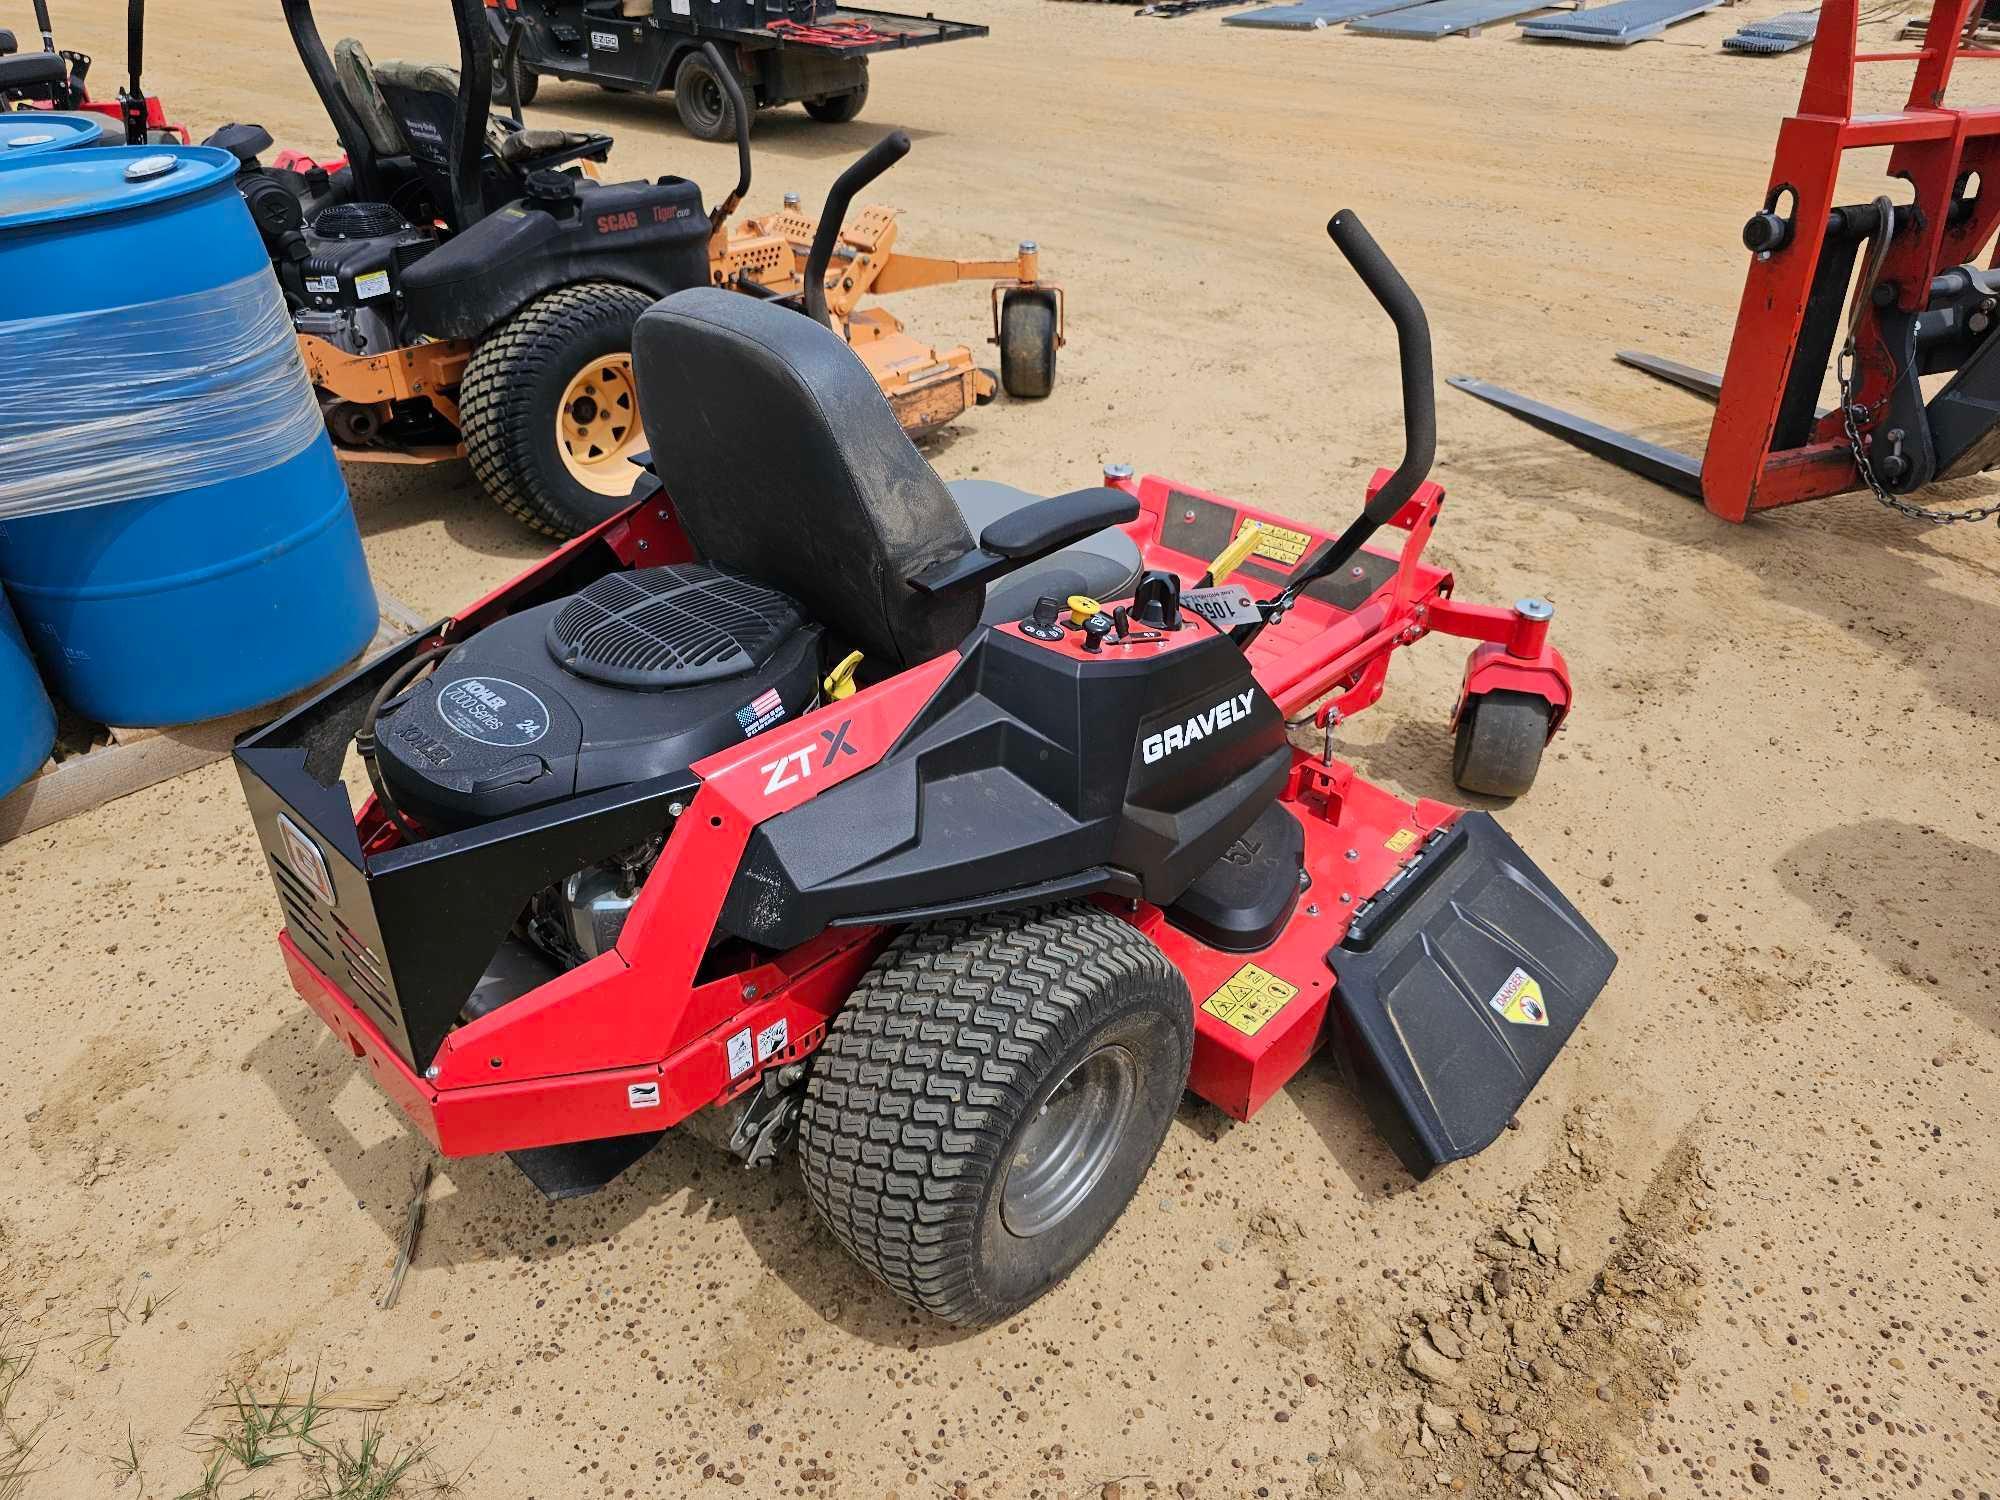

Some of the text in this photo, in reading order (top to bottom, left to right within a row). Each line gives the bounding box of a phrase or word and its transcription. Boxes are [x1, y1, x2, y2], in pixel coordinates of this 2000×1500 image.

[597, 209, 639, 234] SCAG
[446, 687, 478, 709] 7000
[468, 703, 504, 730] Series
[461, 679, 507, 712] KOHLER
[515, 718, 541, 735] 24
[1142, 687, 1255, 765] GRAVELY
[1496, 972, 1528, 1006] DANGER
